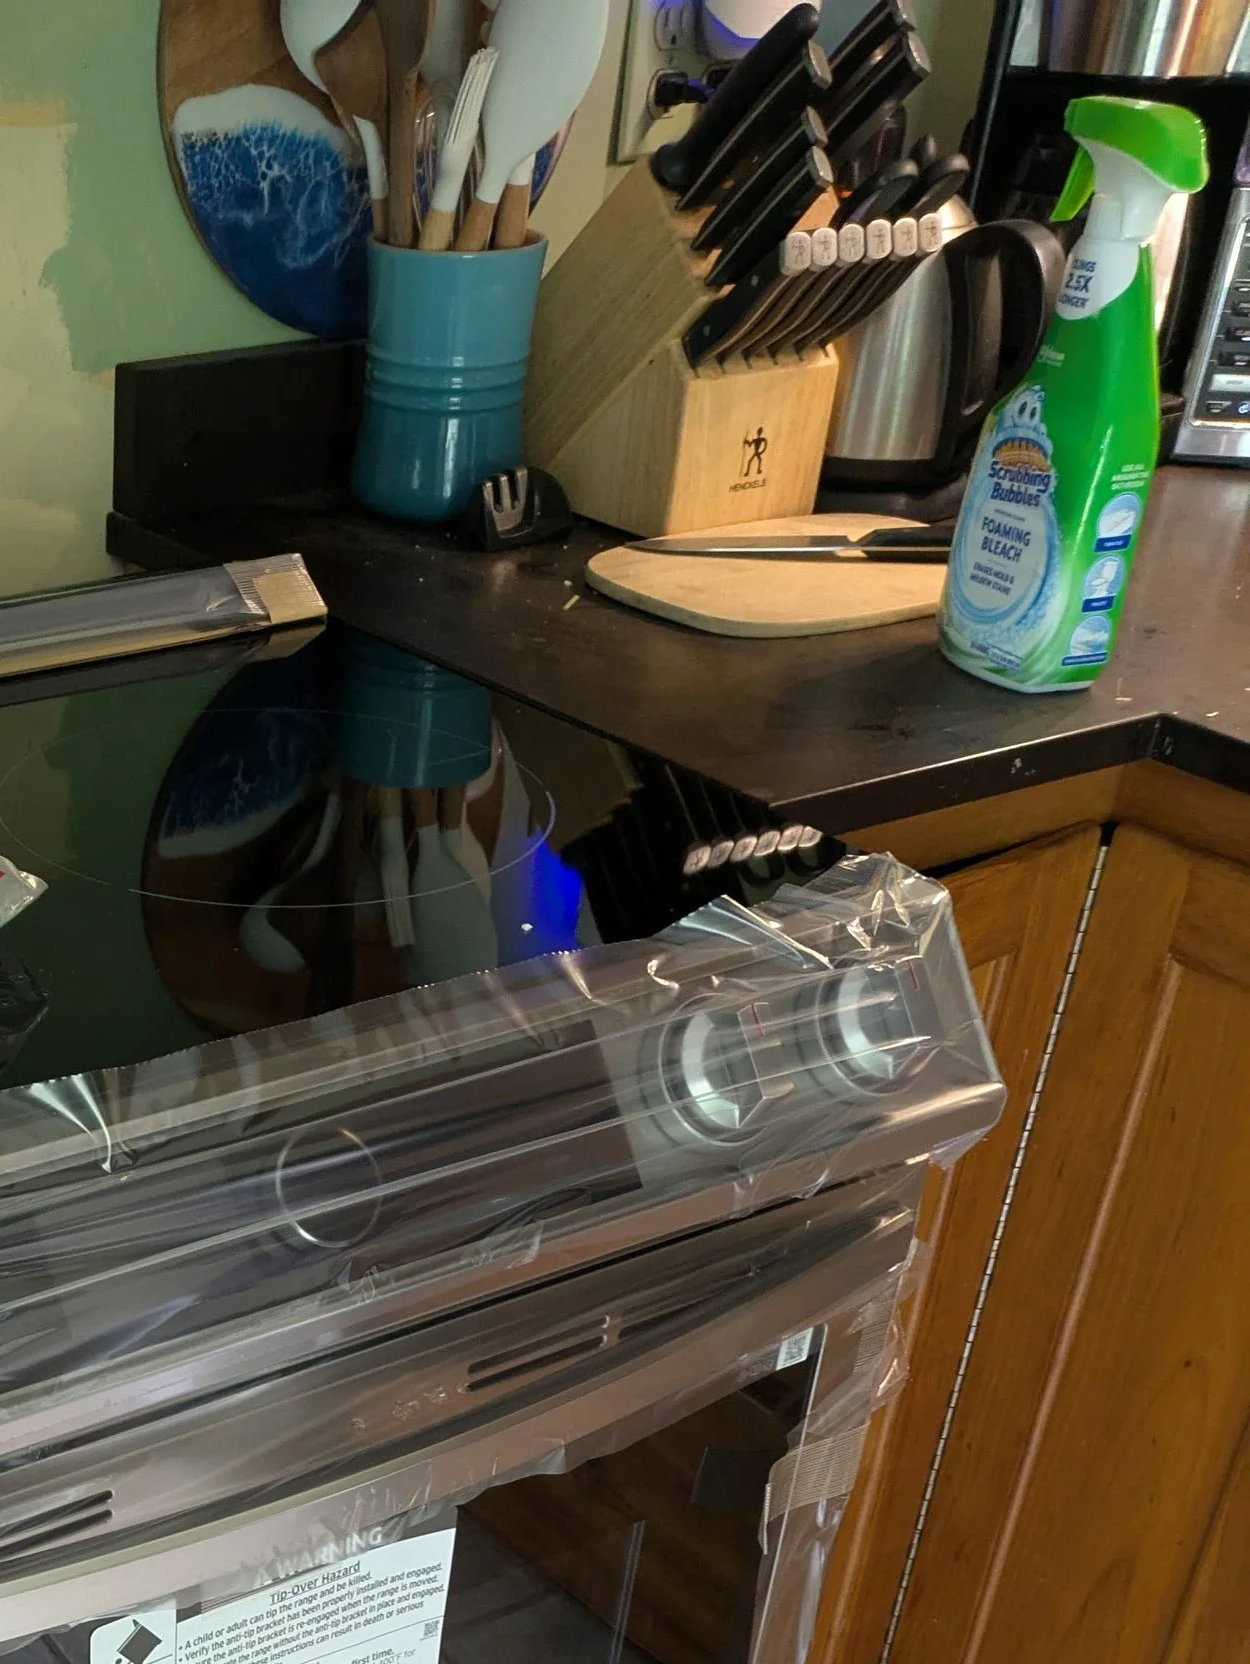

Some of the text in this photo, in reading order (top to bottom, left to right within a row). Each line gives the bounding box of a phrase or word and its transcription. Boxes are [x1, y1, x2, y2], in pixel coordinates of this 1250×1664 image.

[989, 460, 1052, 493] Scrubbing
[990, 481, 1042, 508] Bubbles
[981, 516, 1031, 547] FOAMING
[981, 536, 1023, 564] BLEACH
[275, 1526, 383, 1580] WARNING
[269, 1561, 360, 1604] Tip-Over Hazard
[184, 1646, 209, 1661] Verify
[211, 1641, 224, 1651] the
[226, 1629, 254, 1645] anti-tip
[256, 1615, 285, 1633] bracket
[286, 1612, 300, 1622] has
[301, 1604, 320, 1616] been
[321, 1591, 354, 1611] properly
[356, 1576, 388, 1595] installed
[389, 1572, 404, 1583] and
[193, 1632, 212, 1646] child
[226, 1618, 247, 1634] adult
[249, 1614, 264, 1625] can
[265, 1609, 277, 1619] tip
[278, 1603, 292, 1614] the
[293, 1593, 317, 1608] range
[319, 1585, 334, 1598] and
[336, 1582, 347, 1591] be
[348, 1572, 371, 1587] killed.
[213, 1652, 226, 1662] the
[227, 1640, 256, 1656] anti-tip
[257, 1626, 286, 1644] bracket
[296, 1606, 339, 1629] re-engaged
[340, 1600, 361, 1612] when
[362, 1594, 375, 1604] the
[376, 1586, 399, 1599] range
[238, 1653, 250, 1663] the
[251, 1645, 272, 1658] range
[272, 1632, 300, 1649] without
[301, 1629, 313, 1639] the
[314, 1619, 340, 1634] anti-tip
[341, 1607, 367, 1623] bracket
[376, 1599, 395, 1613] place
[396, 1592, 410, 1604] and
[270, 1640, 314, 1662] instructions
[315, 1634, 329, 1644] can
[330, 1623, 352, 1639] result
[362, 1612, 384, 1627] death
[396, 1601, 424, 1615] serious
[372, 1649, 394, 1661] time.
[403, 1649, 416, 1658] for
